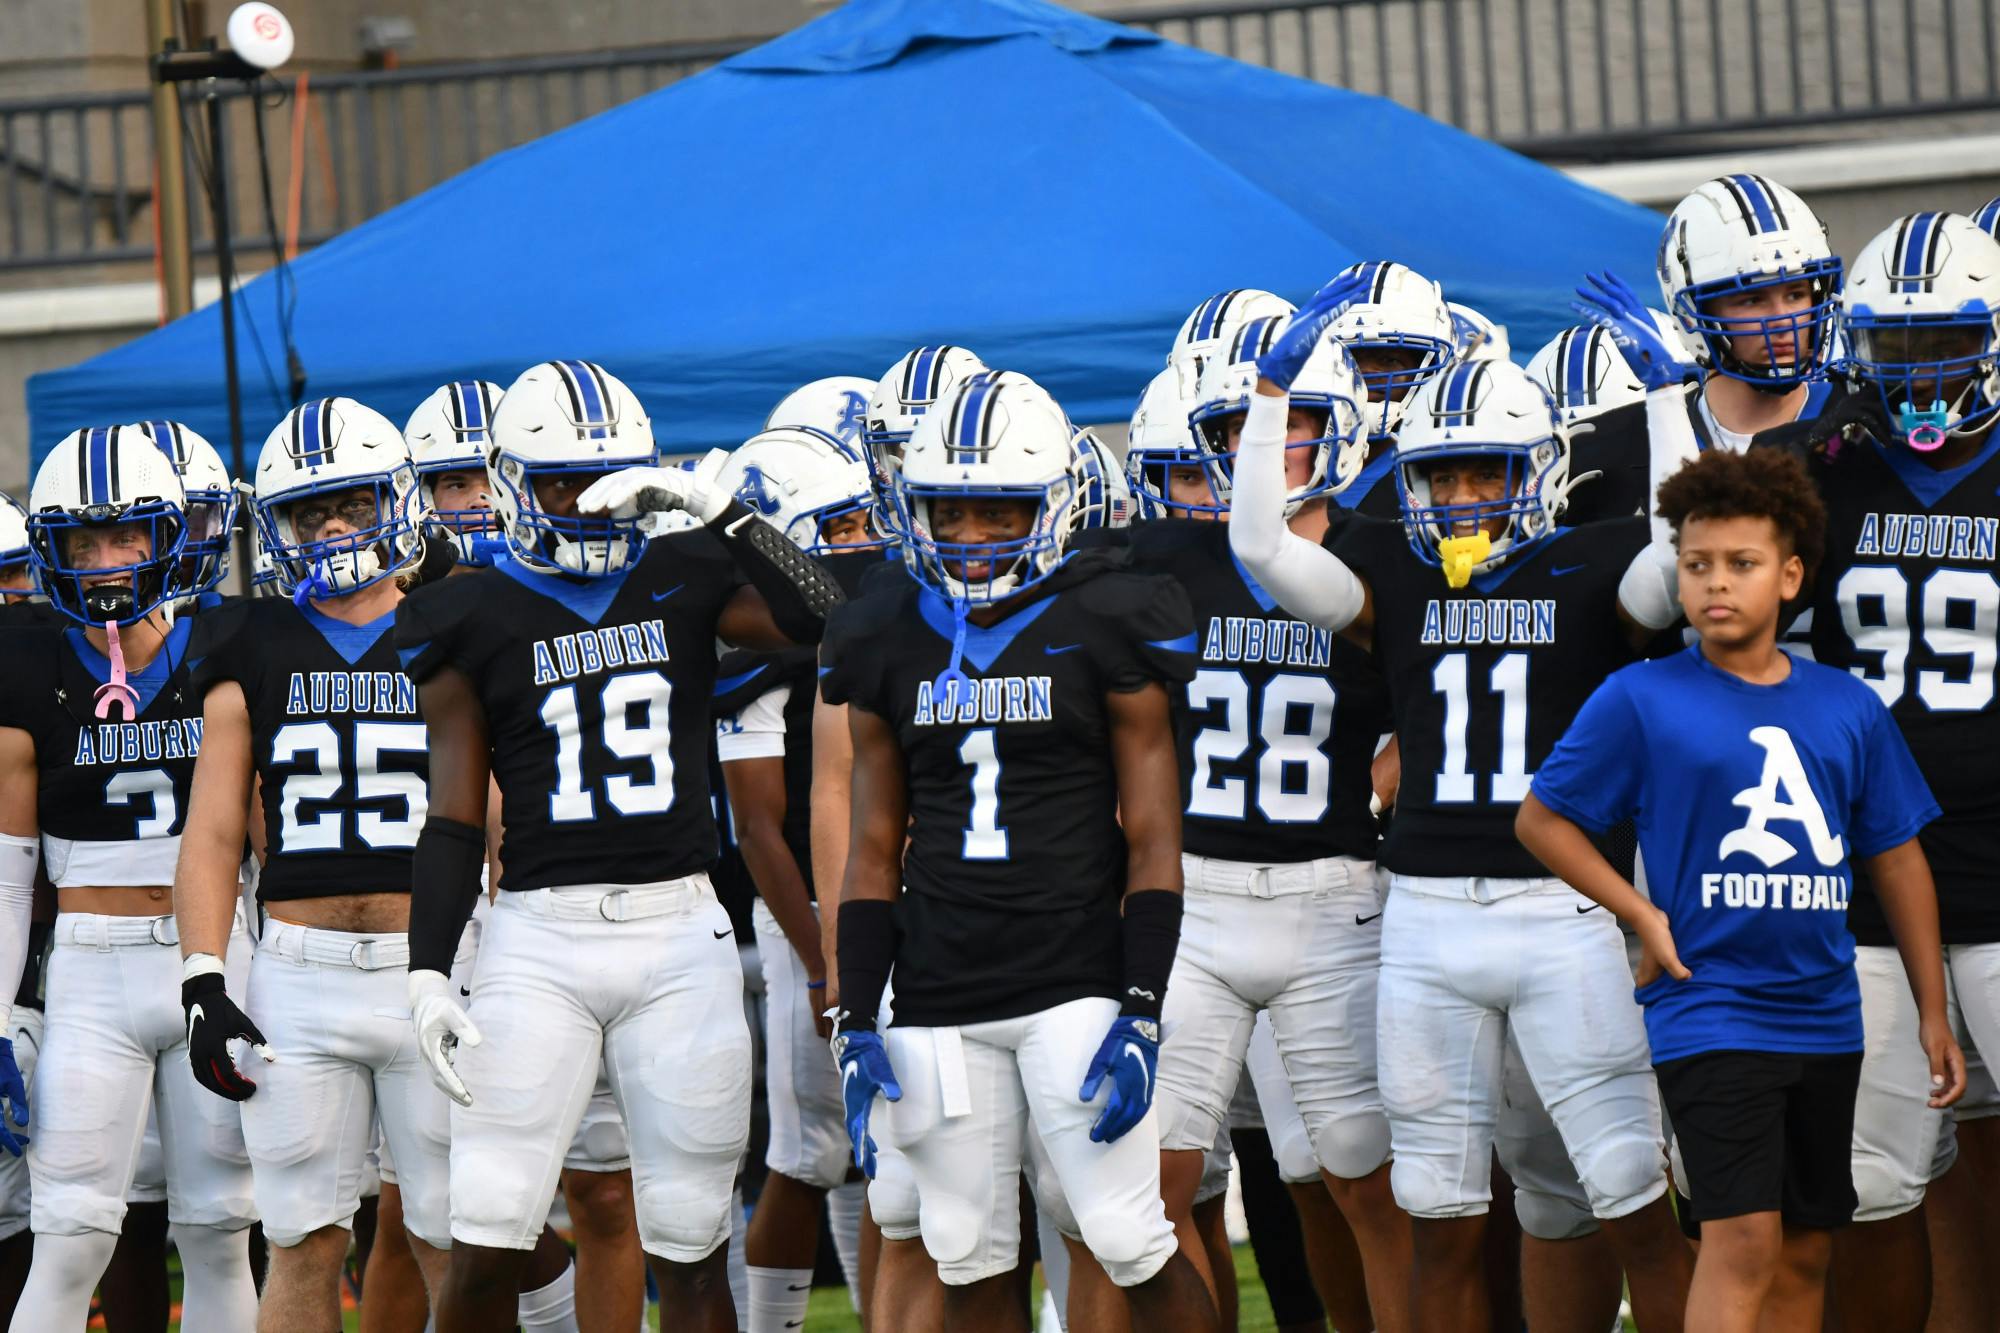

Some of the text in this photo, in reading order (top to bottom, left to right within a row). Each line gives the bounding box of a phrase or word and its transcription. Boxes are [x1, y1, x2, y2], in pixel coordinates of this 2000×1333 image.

[1855, 513, 1999, 561] AUBURN
[533, 619, 670, 686] AUBURN
[1202, 616, 1333, 668] AUBURN
[1421, 599, 1557, 645] AUBURN
[1836, 564, 2000, 713] 99
[286, 671, 417, 715] AUBURN
[913, 676, 1053, 726] AUBURN
[74, 717, 204, 766] AUBURN
[537, 668, 676, 824] 19
[1185, 667, 1337, 825] 28
[1431, 649, 1536, 805] 11
[270, 719, 431, 855] 25
[959, 726, 1010, 861] 1
[1718, 725, 1845, 869] A
[1701, 872, 1850, 911] FOOTBALL
